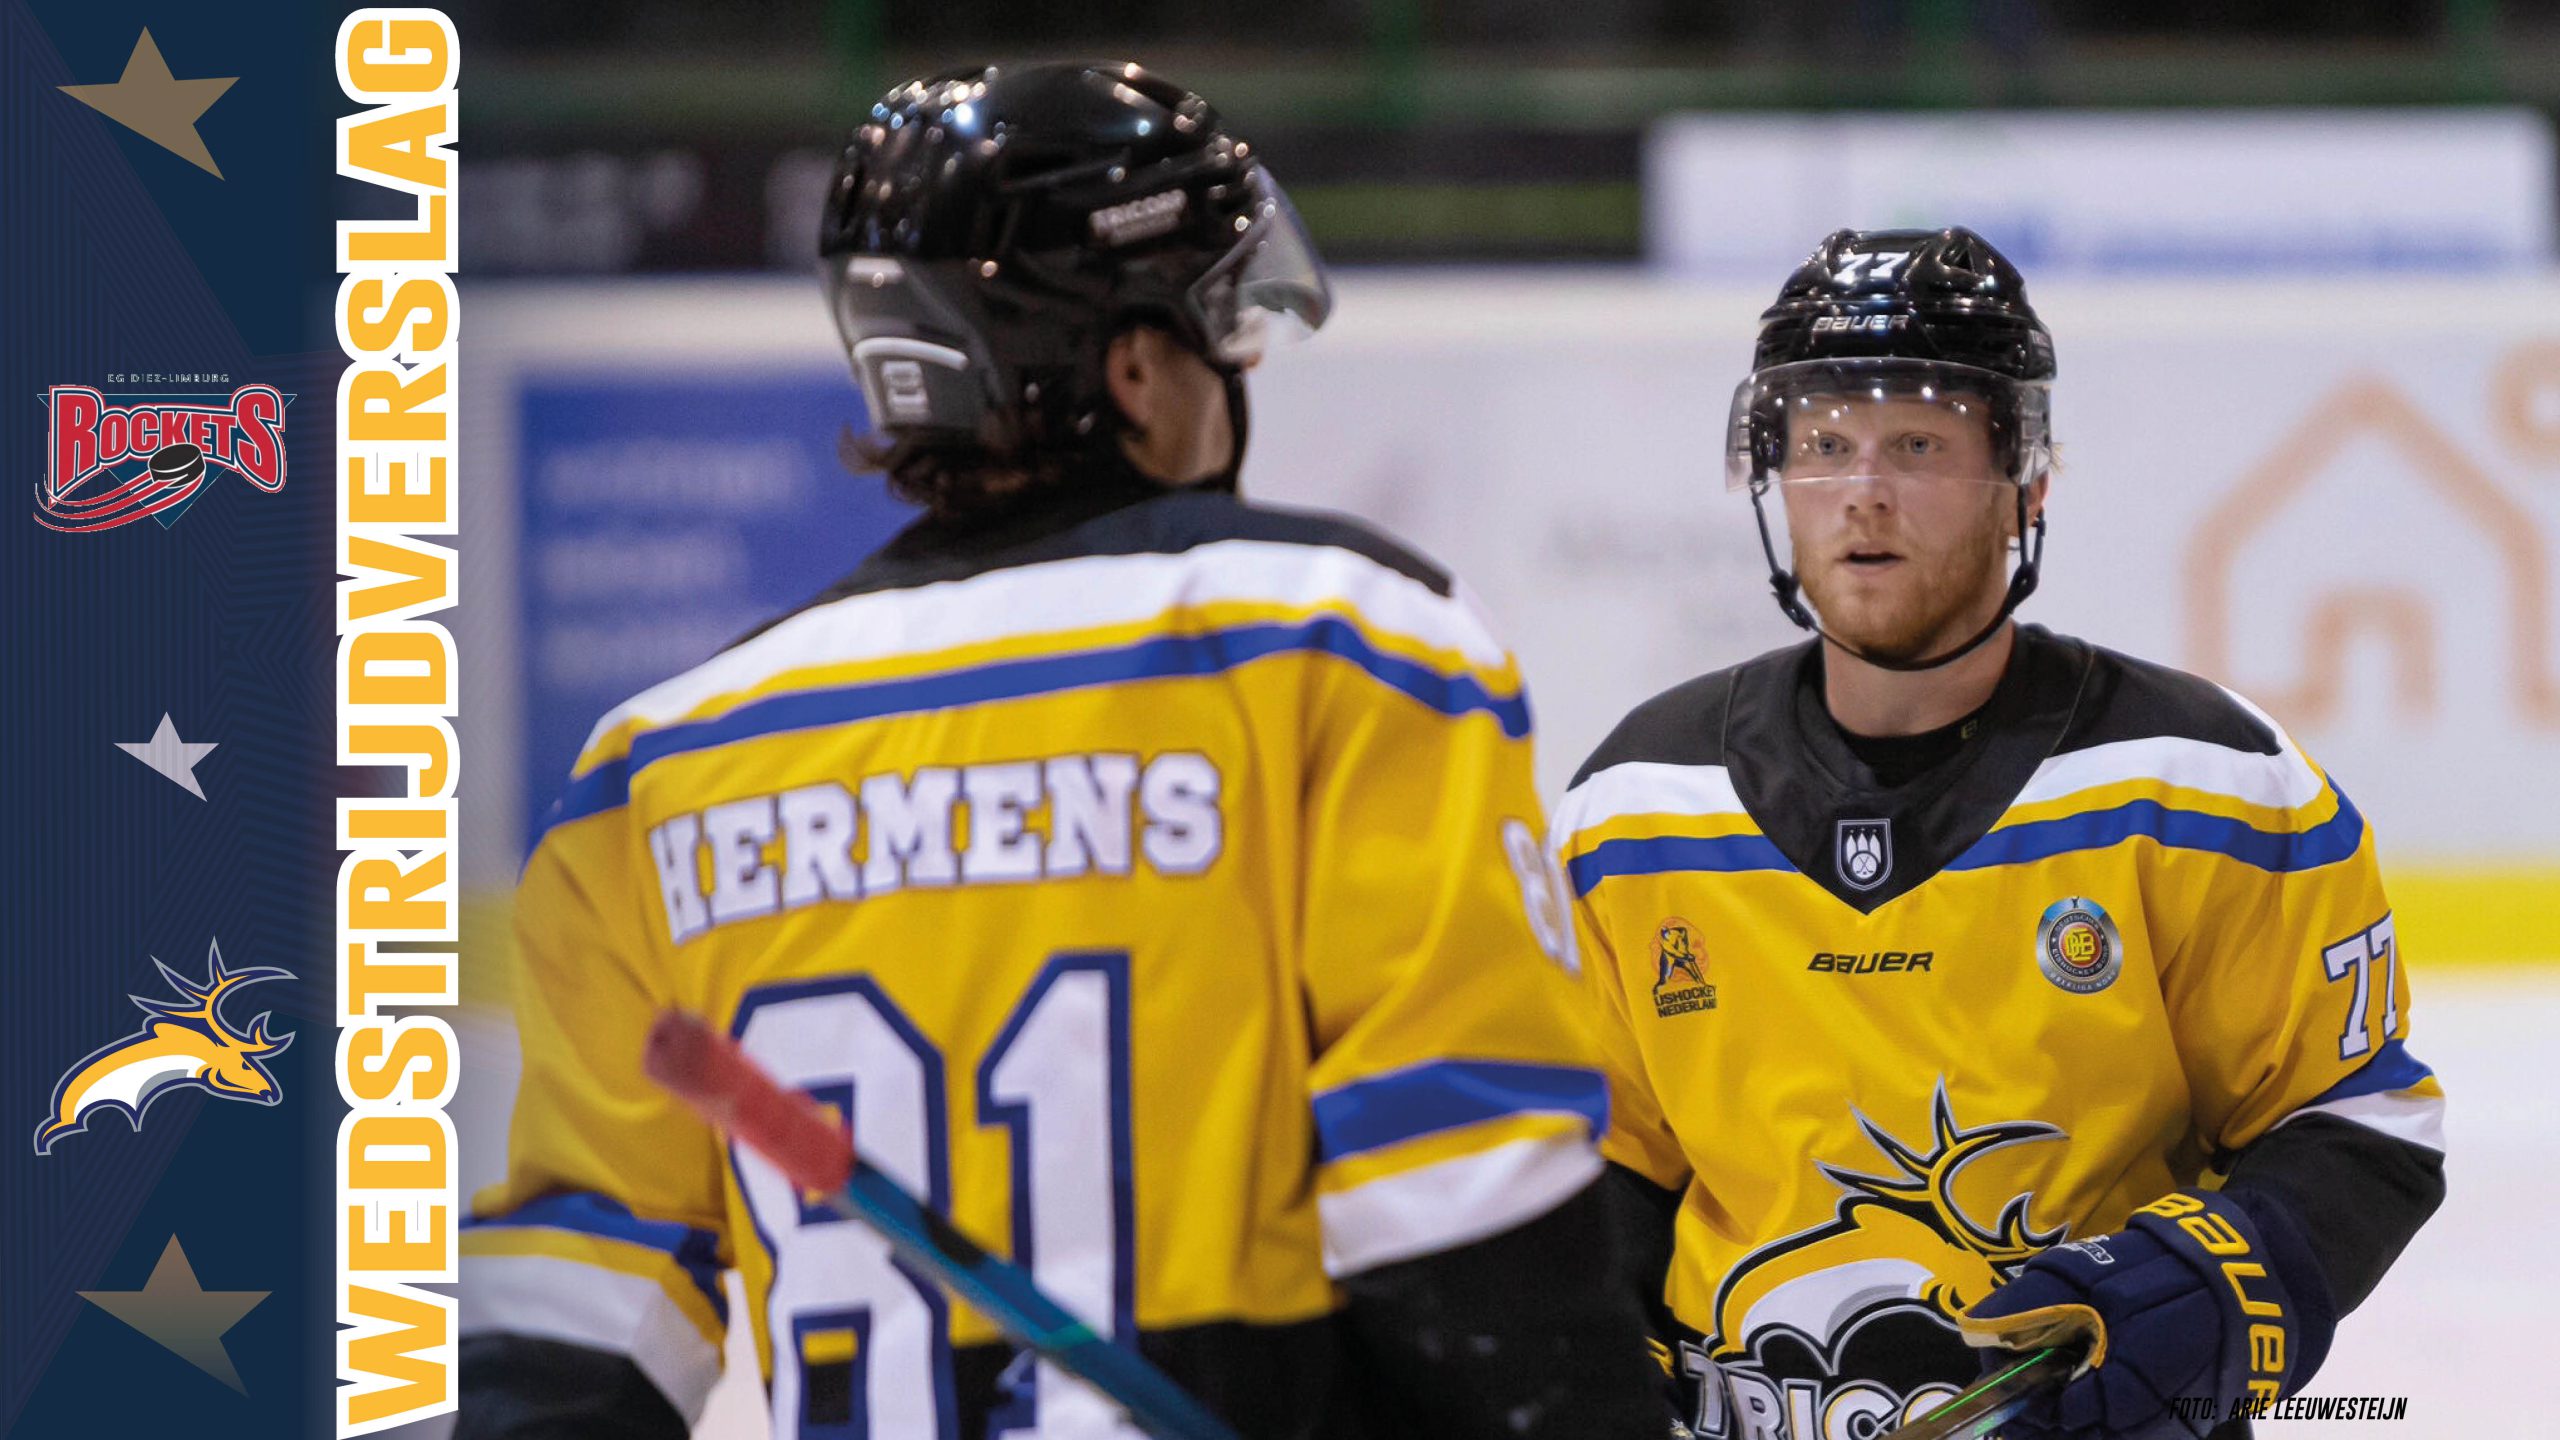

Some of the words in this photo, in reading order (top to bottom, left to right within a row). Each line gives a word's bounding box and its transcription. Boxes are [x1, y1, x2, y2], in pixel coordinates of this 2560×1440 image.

[1834, 252, 1909, 285] 77
[648, 751, 1222, 945] HERMENS
[1807, 951, 1933, 974] BAUER
[2321, 909, 2398, 1061] 77
